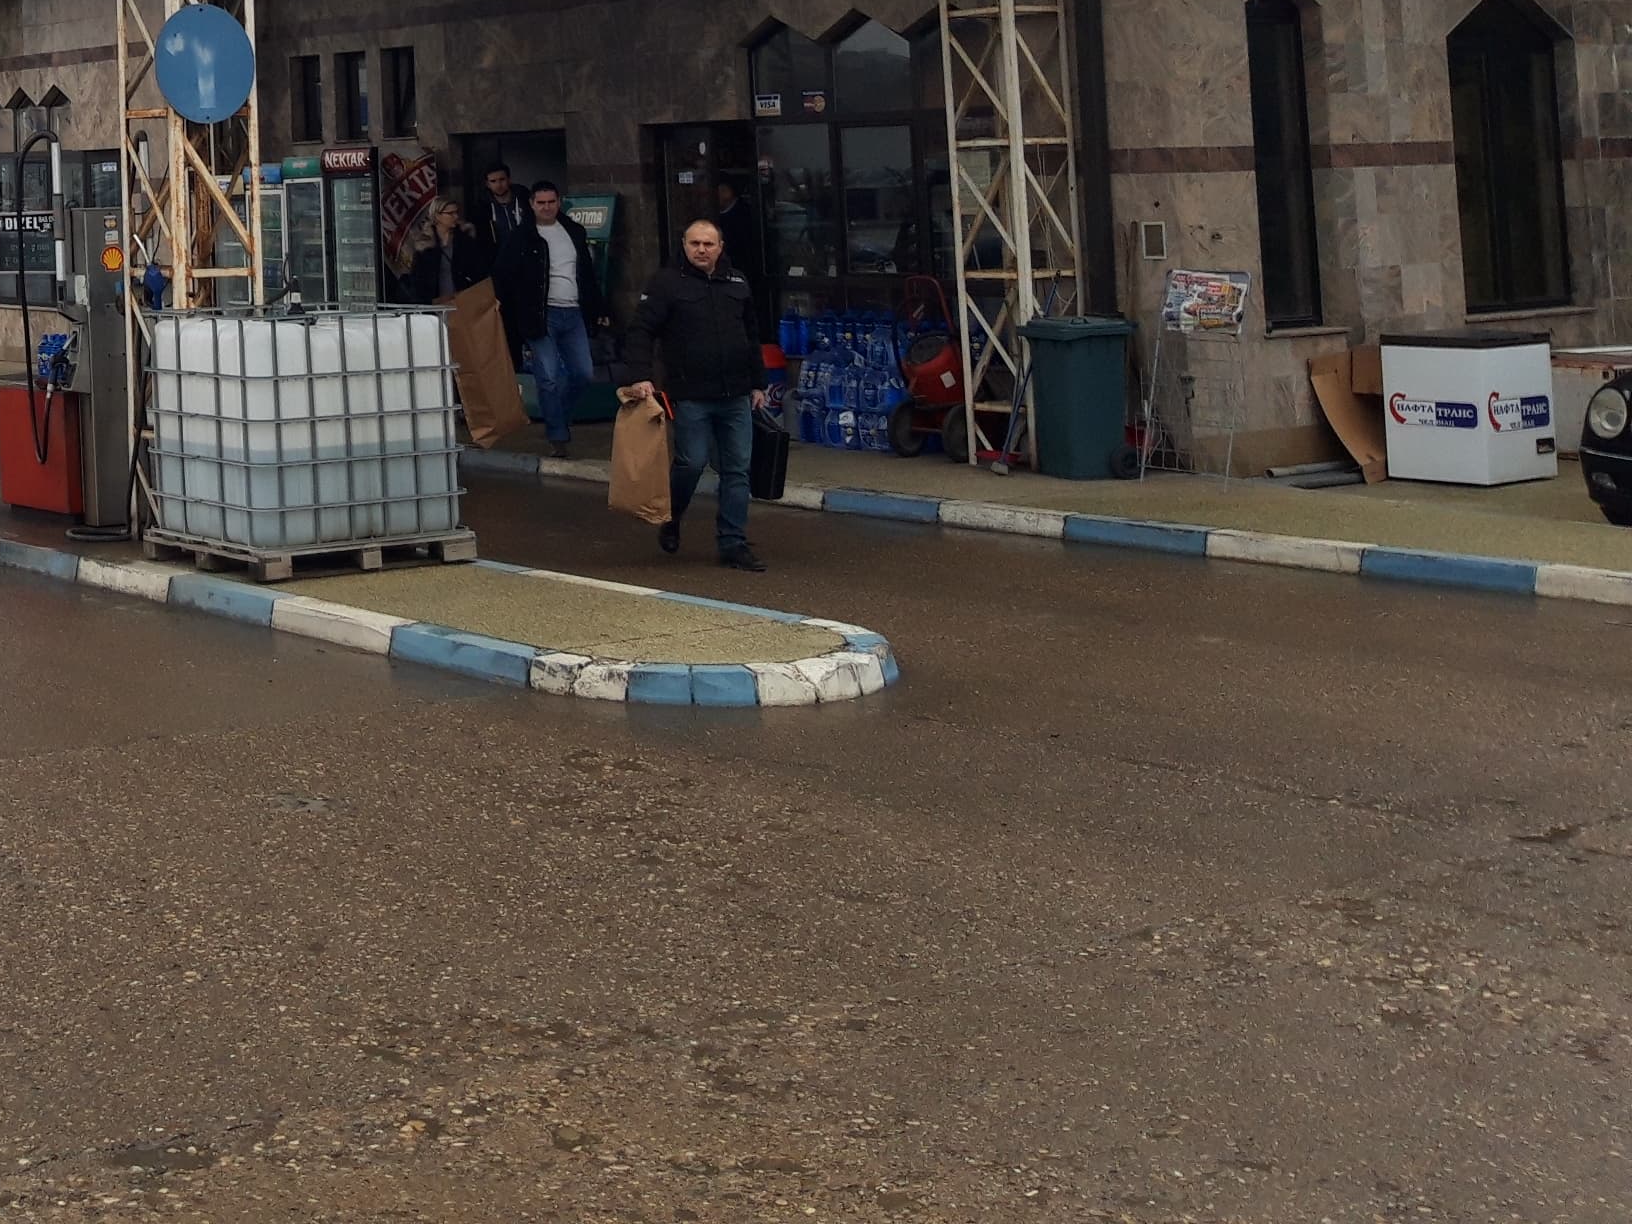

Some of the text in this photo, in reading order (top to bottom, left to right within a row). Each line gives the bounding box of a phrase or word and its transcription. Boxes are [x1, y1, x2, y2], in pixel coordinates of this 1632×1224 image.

[324, 151, 367, 169] NEKTAR
[1396, 403, 1475, 419] НАФТА ТРАНС
